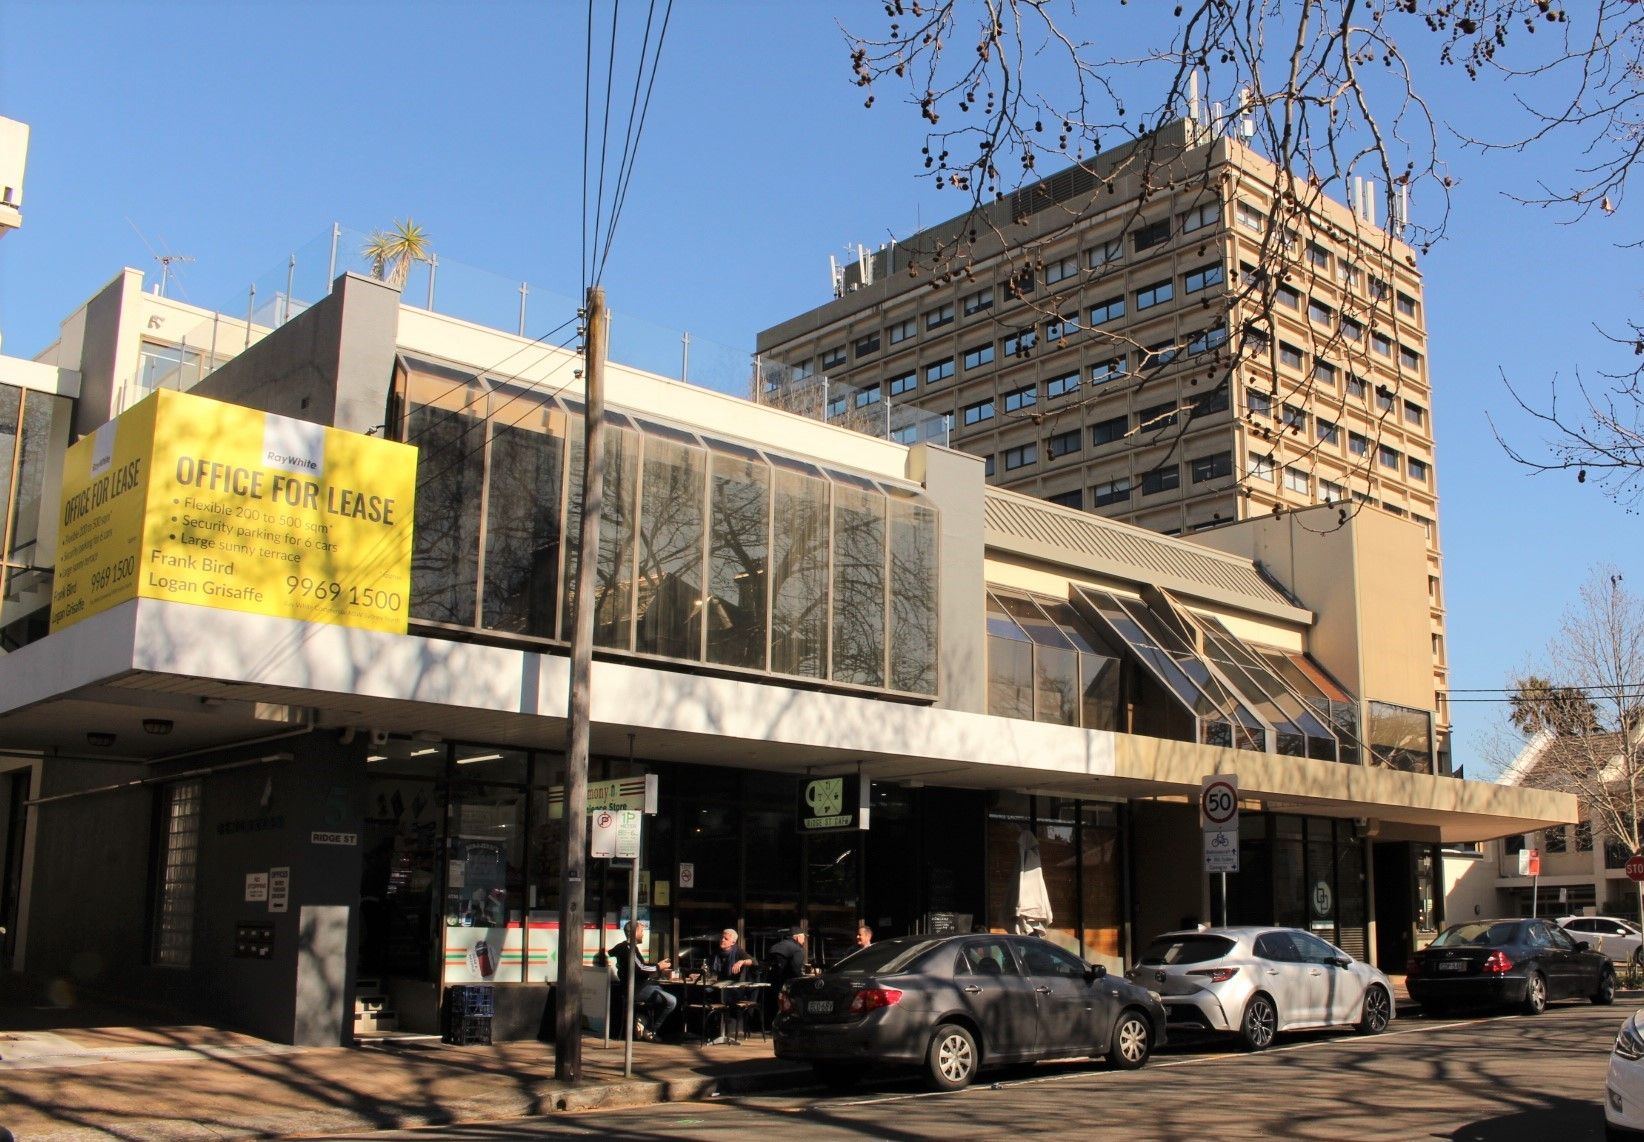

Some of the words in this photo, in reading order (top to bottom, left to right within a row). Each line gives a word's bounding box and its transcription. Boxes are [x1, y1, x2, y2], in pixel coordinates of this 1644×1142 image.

[267, 452, 317, 469] RayWhite
[65, 487, 90, 527] OFFICE
[91, 477, 109, 511] FOR
[111, 458, 141, 499] LEASE
[176, 456, 264, 499] OFFICE
[271, 475, 319, 510] FOR
[327, 486, 394, 525] LEASE
[184, 497, 233, 515] Flexible
[236, 507, 260, 520] 200
[264, 514, 275, 523] to
[279, 515, 302, 528] 500
[181, 533, 215, 549] Large
[218, 541, 256, 557] sunny
[259, 548, 301, 563] terrace
[182, 514, 234, 534] Security
[236, 527, 281, 544] parking
[284, 533, 300, 546] for
[304, 537, 312, 548] 6
[315, 541, 338, 553] cars
[91, 566, 111, 593] 9969
[112, 555, 135, 583] 1500
[151, 549, 197, 569] Frank
[202, 557, 235, 575] Bird
[149, 572, 198, 593] Logan
[202, 580, 263, 603] Grisaffe
[286, 575, 341, 602] 9969
[349, 586, 401, 611] 1500
[1208, 793, 1231, 812] 50
[313, 833, 341, 843] RIDGE
[344, 834, 355, 844] ST
[1627, 864, 1644, 874] STO
